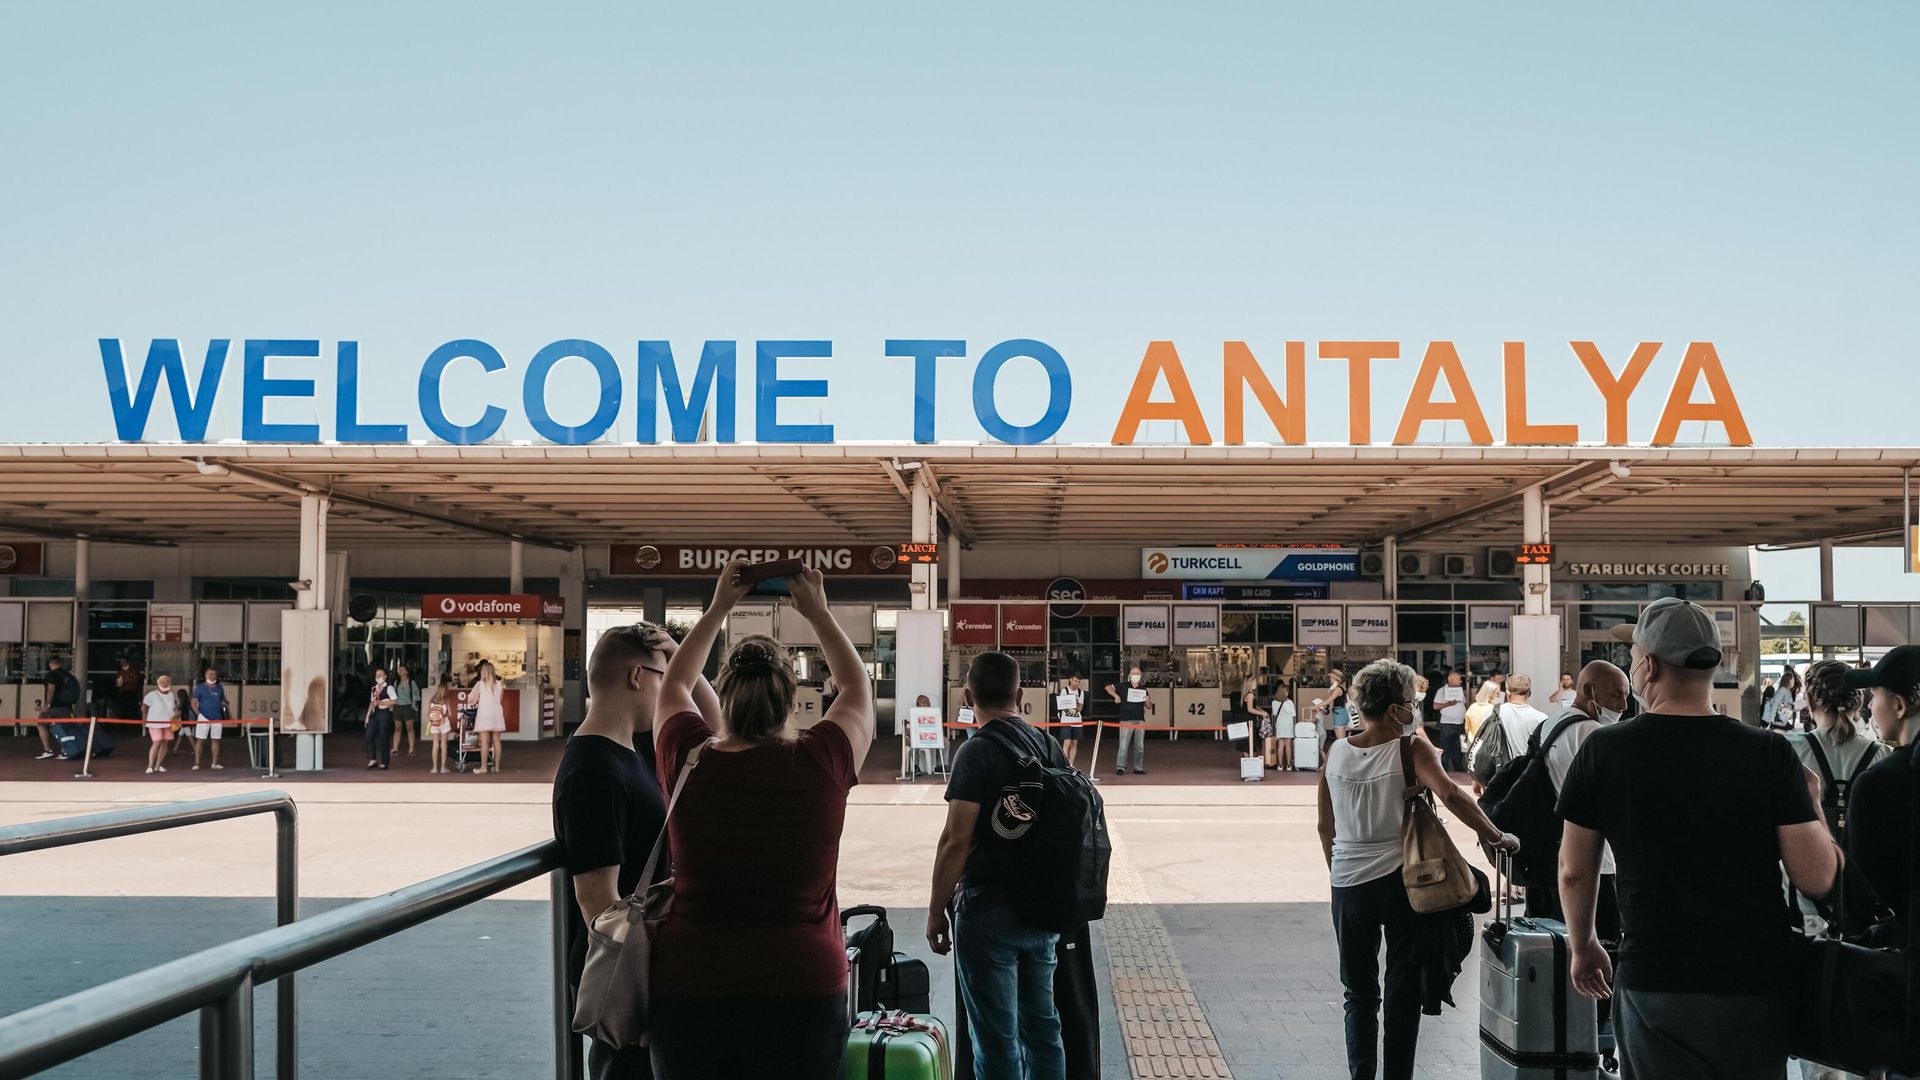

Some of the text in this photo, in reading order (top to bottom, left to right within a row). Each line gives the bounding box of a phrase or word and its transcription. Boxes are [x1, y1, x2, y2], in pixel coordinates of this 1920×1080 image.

[98, 338, 1754, 446] WELCOME TO ANTALYA
[1521, 544, 1552, 554] TAXI
[1171, 557, 1242, 569] TURKCELL
[1297, 562, 1355, 571] GOLDPHONE
[1570, 563, 1731, 576] STARBUCKS COFFEE
[1241, 588, 1272, 597] SIM CARD
[458, 599, 521, 612] vodafone
[1014, 623, 1042, 631] corendon
[1144, 621, 1166, 629] PEGAS
[1194, 621, 1215, 629] PEGAS
[1317, 619, 1339, 627] PEGAS
[1367, 619, 1389, 627] PEGAS
[1188, 703, 1206, 715] 42
